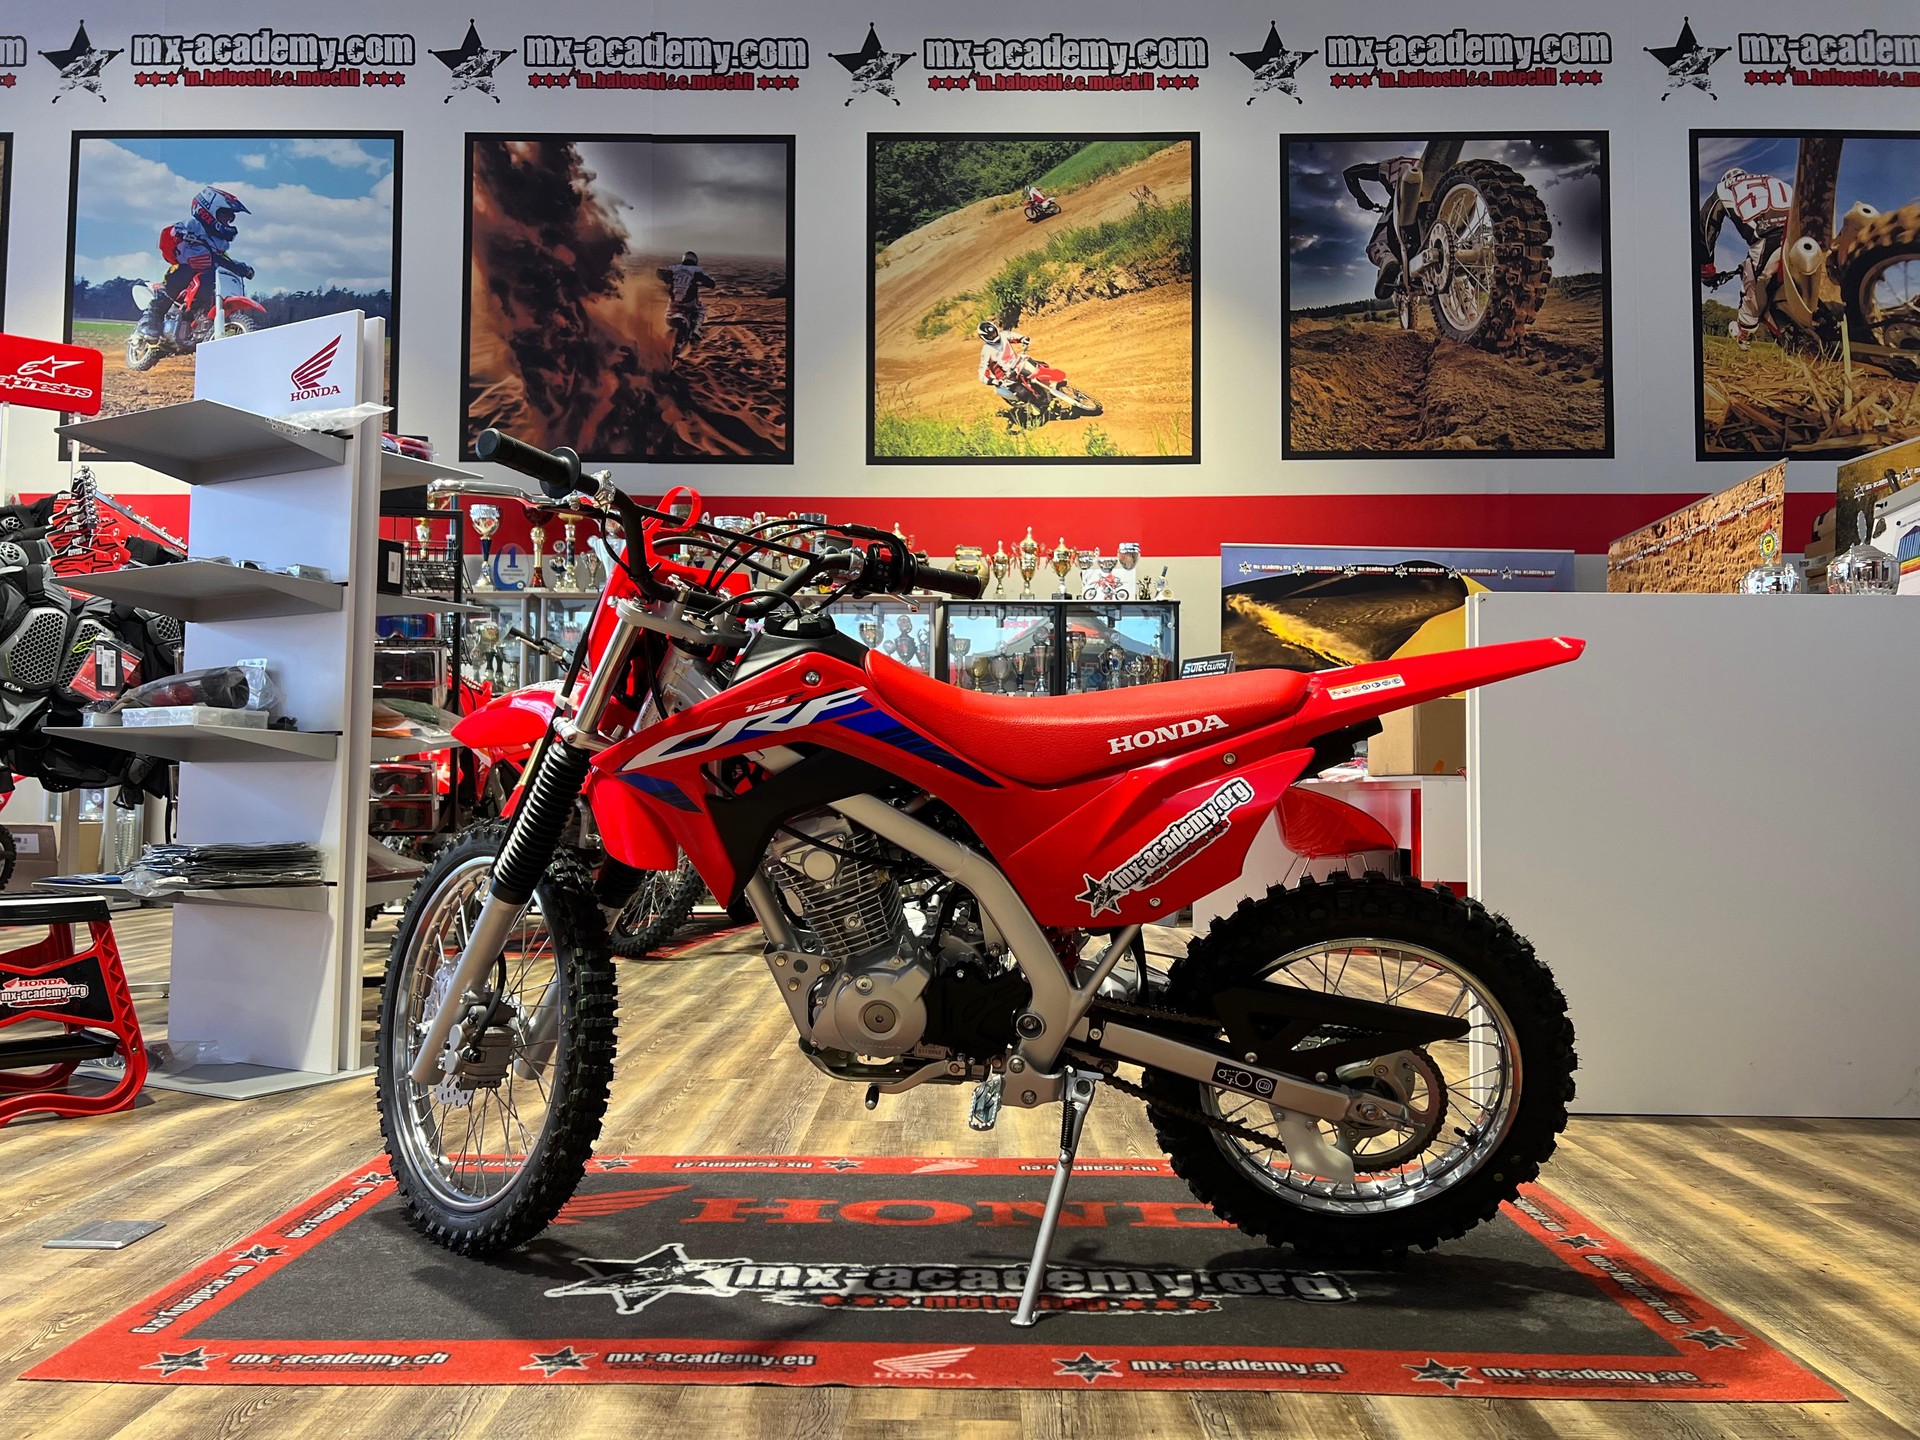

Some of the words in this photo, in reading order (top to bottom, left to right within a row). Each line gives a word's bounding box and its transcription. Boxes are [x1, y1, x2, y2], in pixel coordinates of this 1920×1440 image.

[132, 28, 416, 71] mx-academy.com
[524, 32, 809, 74] mx-academy.com
[924, 33, 1209, 76] mx-academy.com
[1326, 29, 1612, 71] mx-academy.com
[1732, 177, 1793, 223] 50
[290, 385, 341, 402] HONDA
[507, 546, 518, 568] 1
[1183, 661, 1208, 674] SUTER
[1207, 662, 1227, 671] CLUTCH
[621, 685, 869, 772] CRF
[1107, 714, 1230, 754] HONDA
[1112, 780, 1253, 889] mx-academy.org
[19, 978, 67, 987] HONDA
[1, 986, 88, 1001] mx-academy.org
[1018, 1163, 1159, 1173] mx-acadey.eu
[680, 1198, 1238, 1229] HOND
[924, 1295, 1109, 1312] motohop
[228, 1352, 451, 1367] mx-academy.ch
[602, 1352, 817, 1367] mx-academy.eu
[1129, 1359, 1348, 1375] mx-academy.at
[873, 1371, 977, 1379] HONDA
[1478, 1366, 1703, 1383] mx-academy.ae
